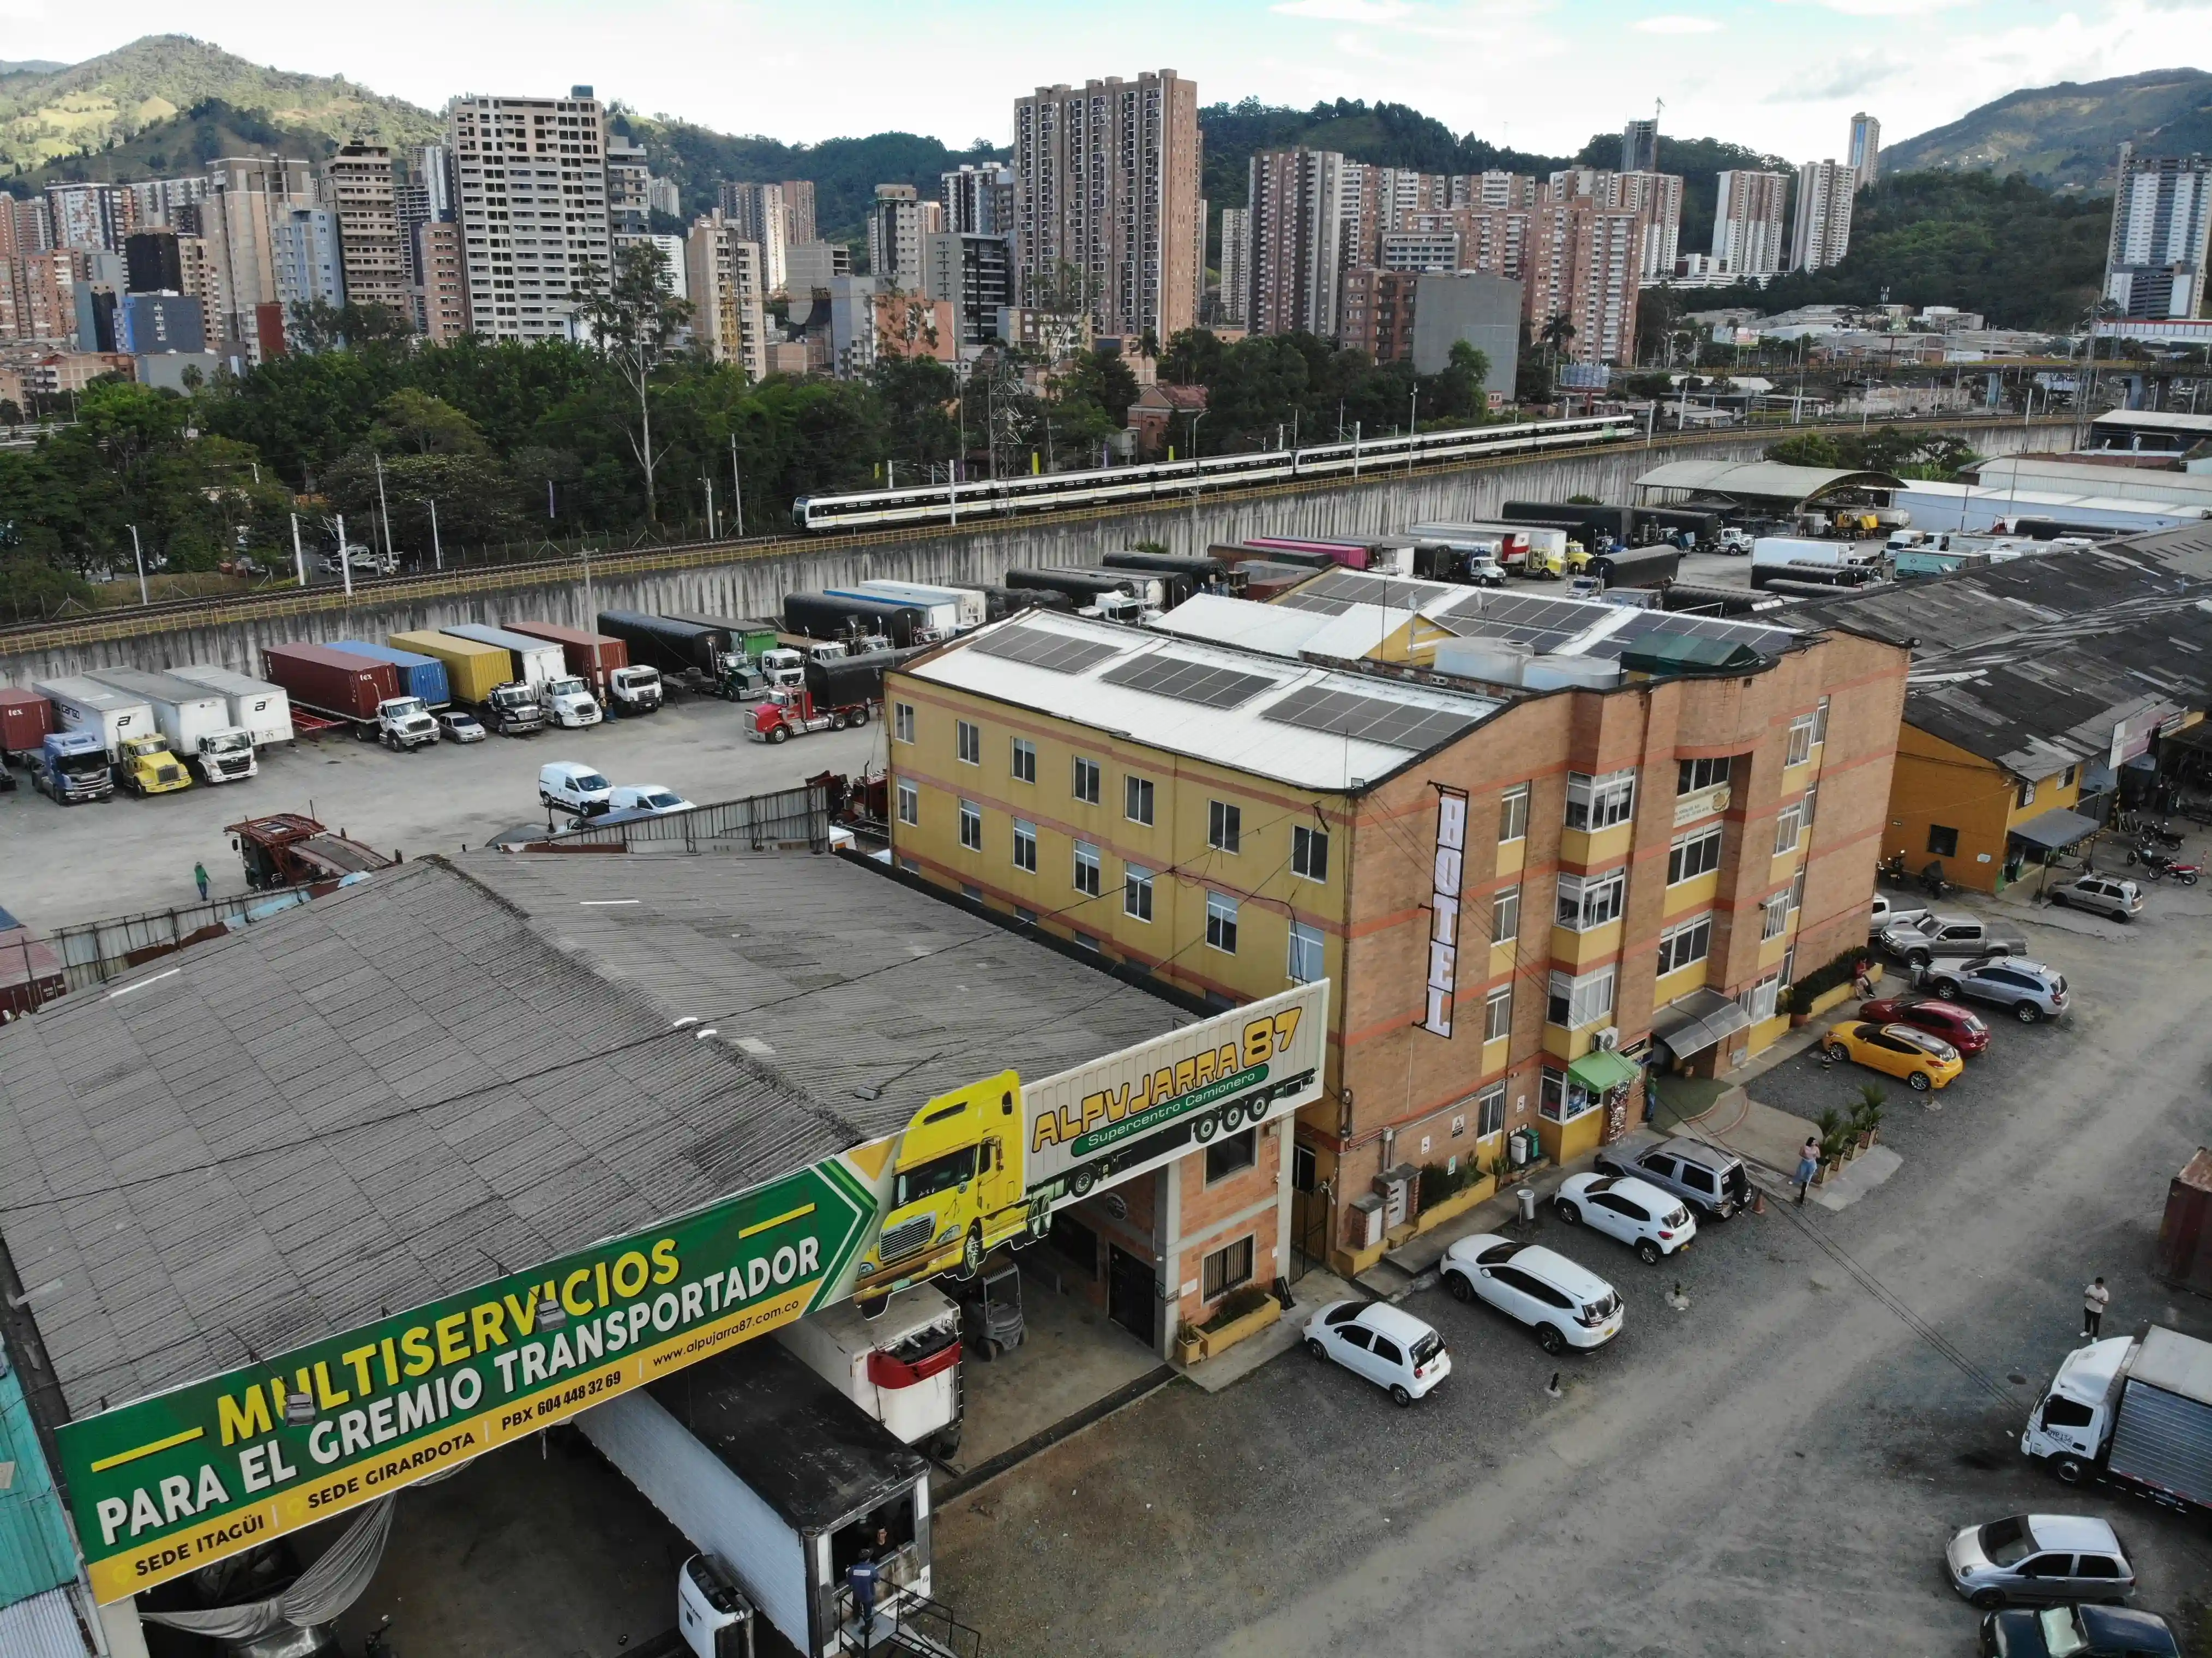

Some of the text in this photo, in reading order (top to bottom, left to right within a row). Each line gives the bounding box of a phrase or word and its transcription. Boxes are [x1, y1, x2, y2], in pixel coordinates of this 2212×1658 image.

[1424, 796, 1466, 1037] HOTEL
[1242, 1006, 1302, 1068] 87
[1089, 1072, 1255, 1147] Supercentro Camionero
[653, 1300, 799, 1367] www.alpujarra87.com.co
[96, 1235, 820, 1545] PARA EL GREMIO TRANSPORTADOR
[502, 1371, 621, 1431] PBX 604 448 32 69
[308, 1432, 476, 1509] SEDE GIRARDOTA
[135, 1514, 265, 1576] SEDE ITAGÜI
